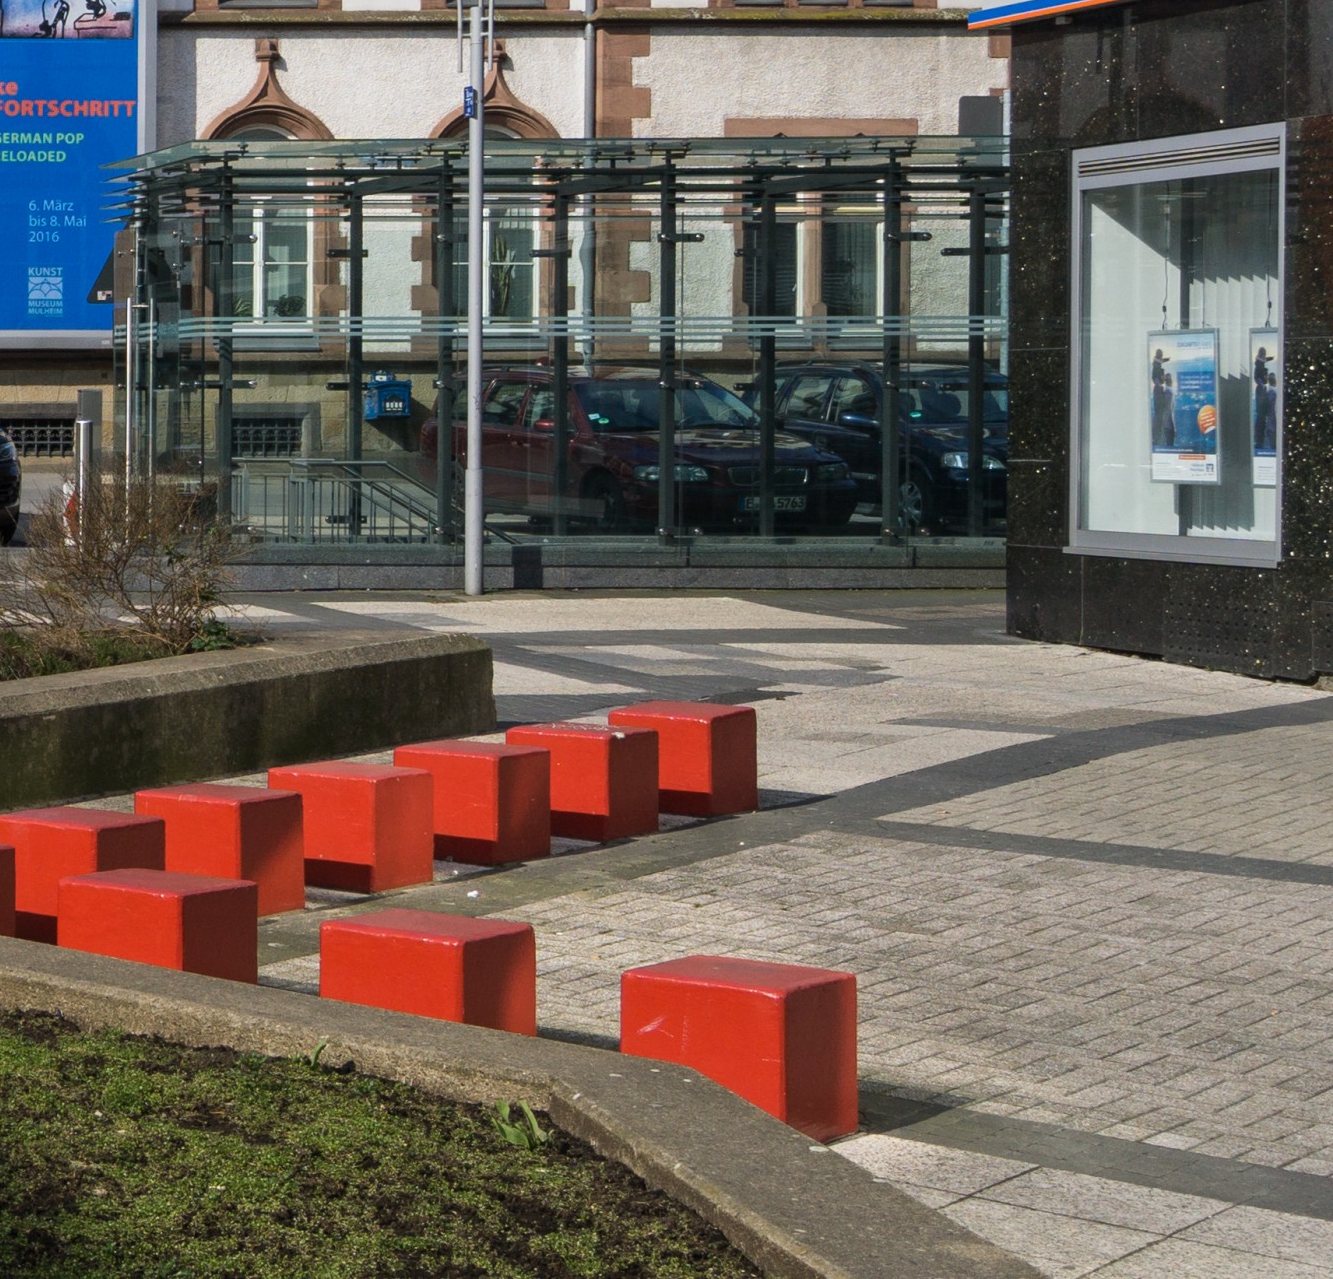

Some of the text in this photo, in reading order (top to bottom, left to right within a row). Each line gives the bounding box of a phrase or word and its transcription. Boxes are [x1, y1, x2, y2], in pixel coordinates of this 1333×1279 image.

[56, 132, 85, 144] POP
[28, 199, 74, 211] 6. März
[29, 214, 87, 227] bis 8. Mai
[28, 231, 60, 243] 2016
[28, 267, 63, 276] KUNST
[28, 300, 63, 308] MUSEUM
[777, 497, 806, 509] 5763
